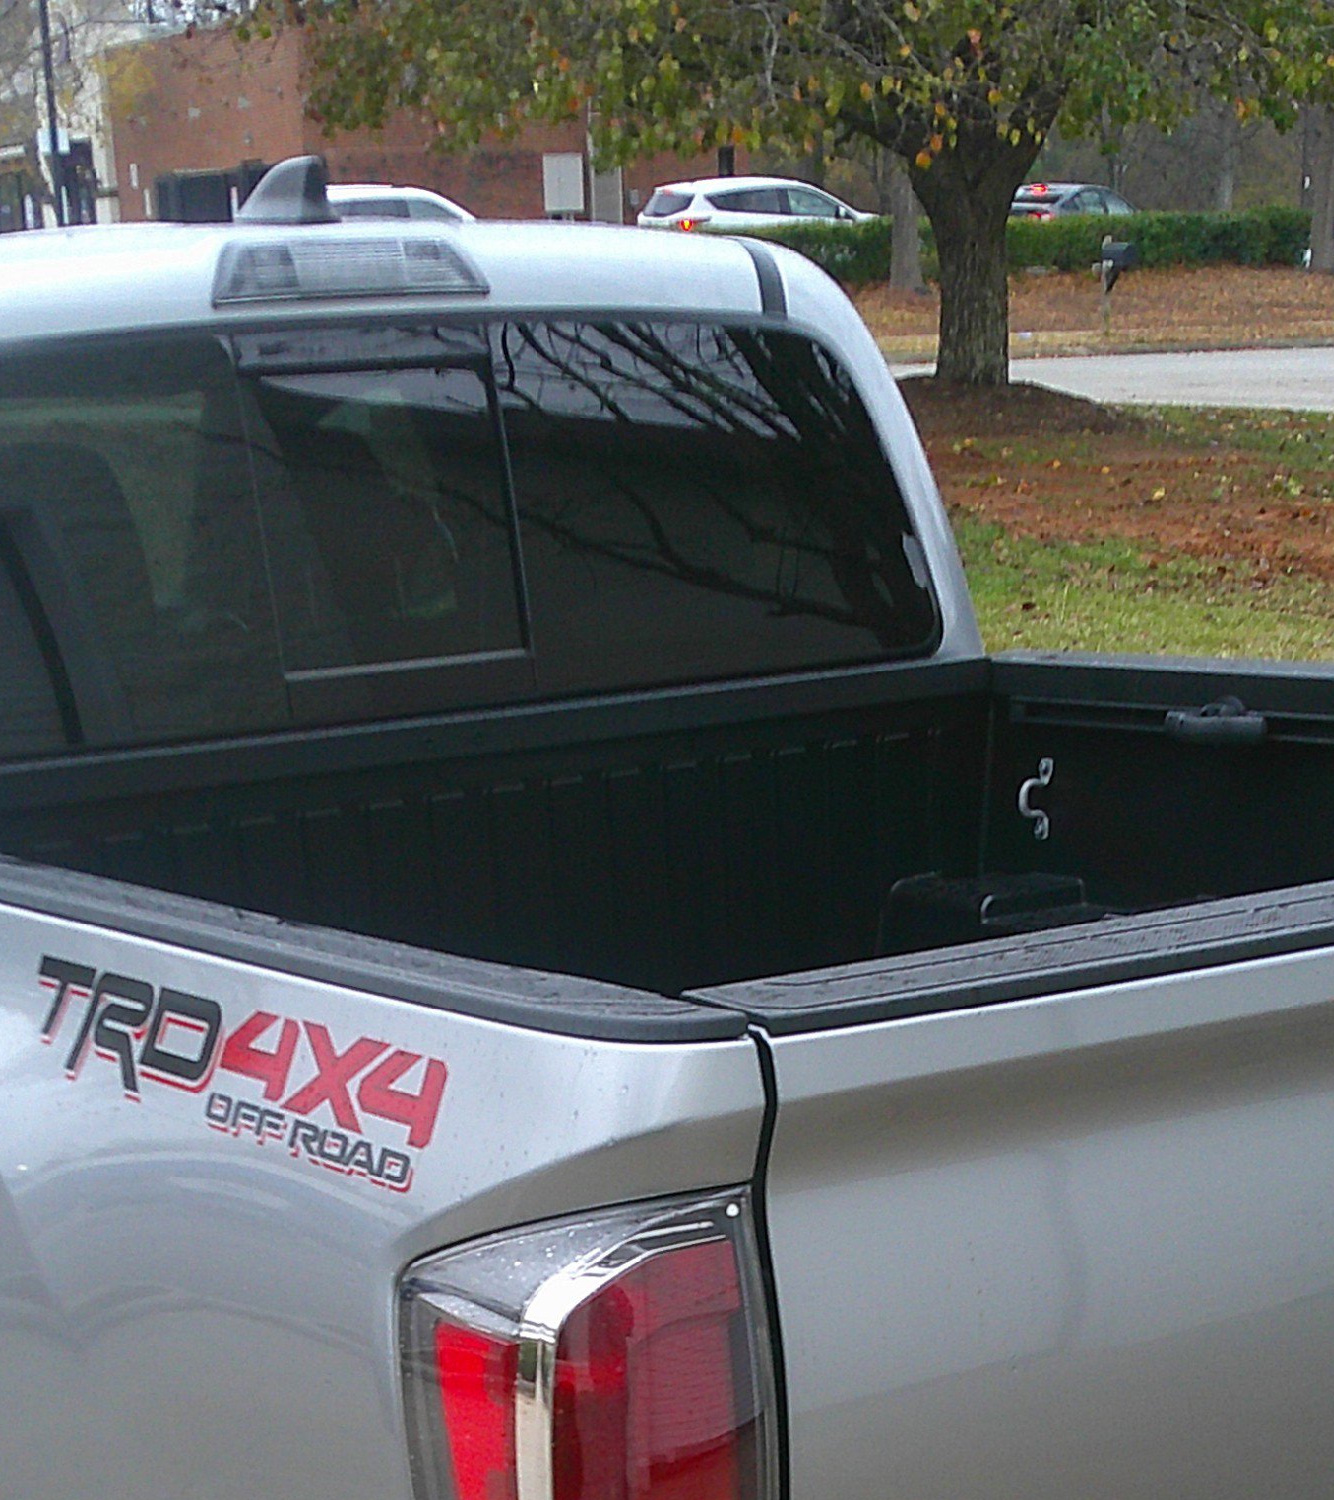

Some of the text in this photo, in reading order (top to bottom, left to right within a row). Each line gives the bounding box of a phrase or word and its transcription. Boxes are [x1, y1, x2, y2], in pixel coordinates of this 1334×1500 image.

[38, 954, 447, 1149] TRD 4X4
[205, 1092, 414, 1193] OFF ROAD
